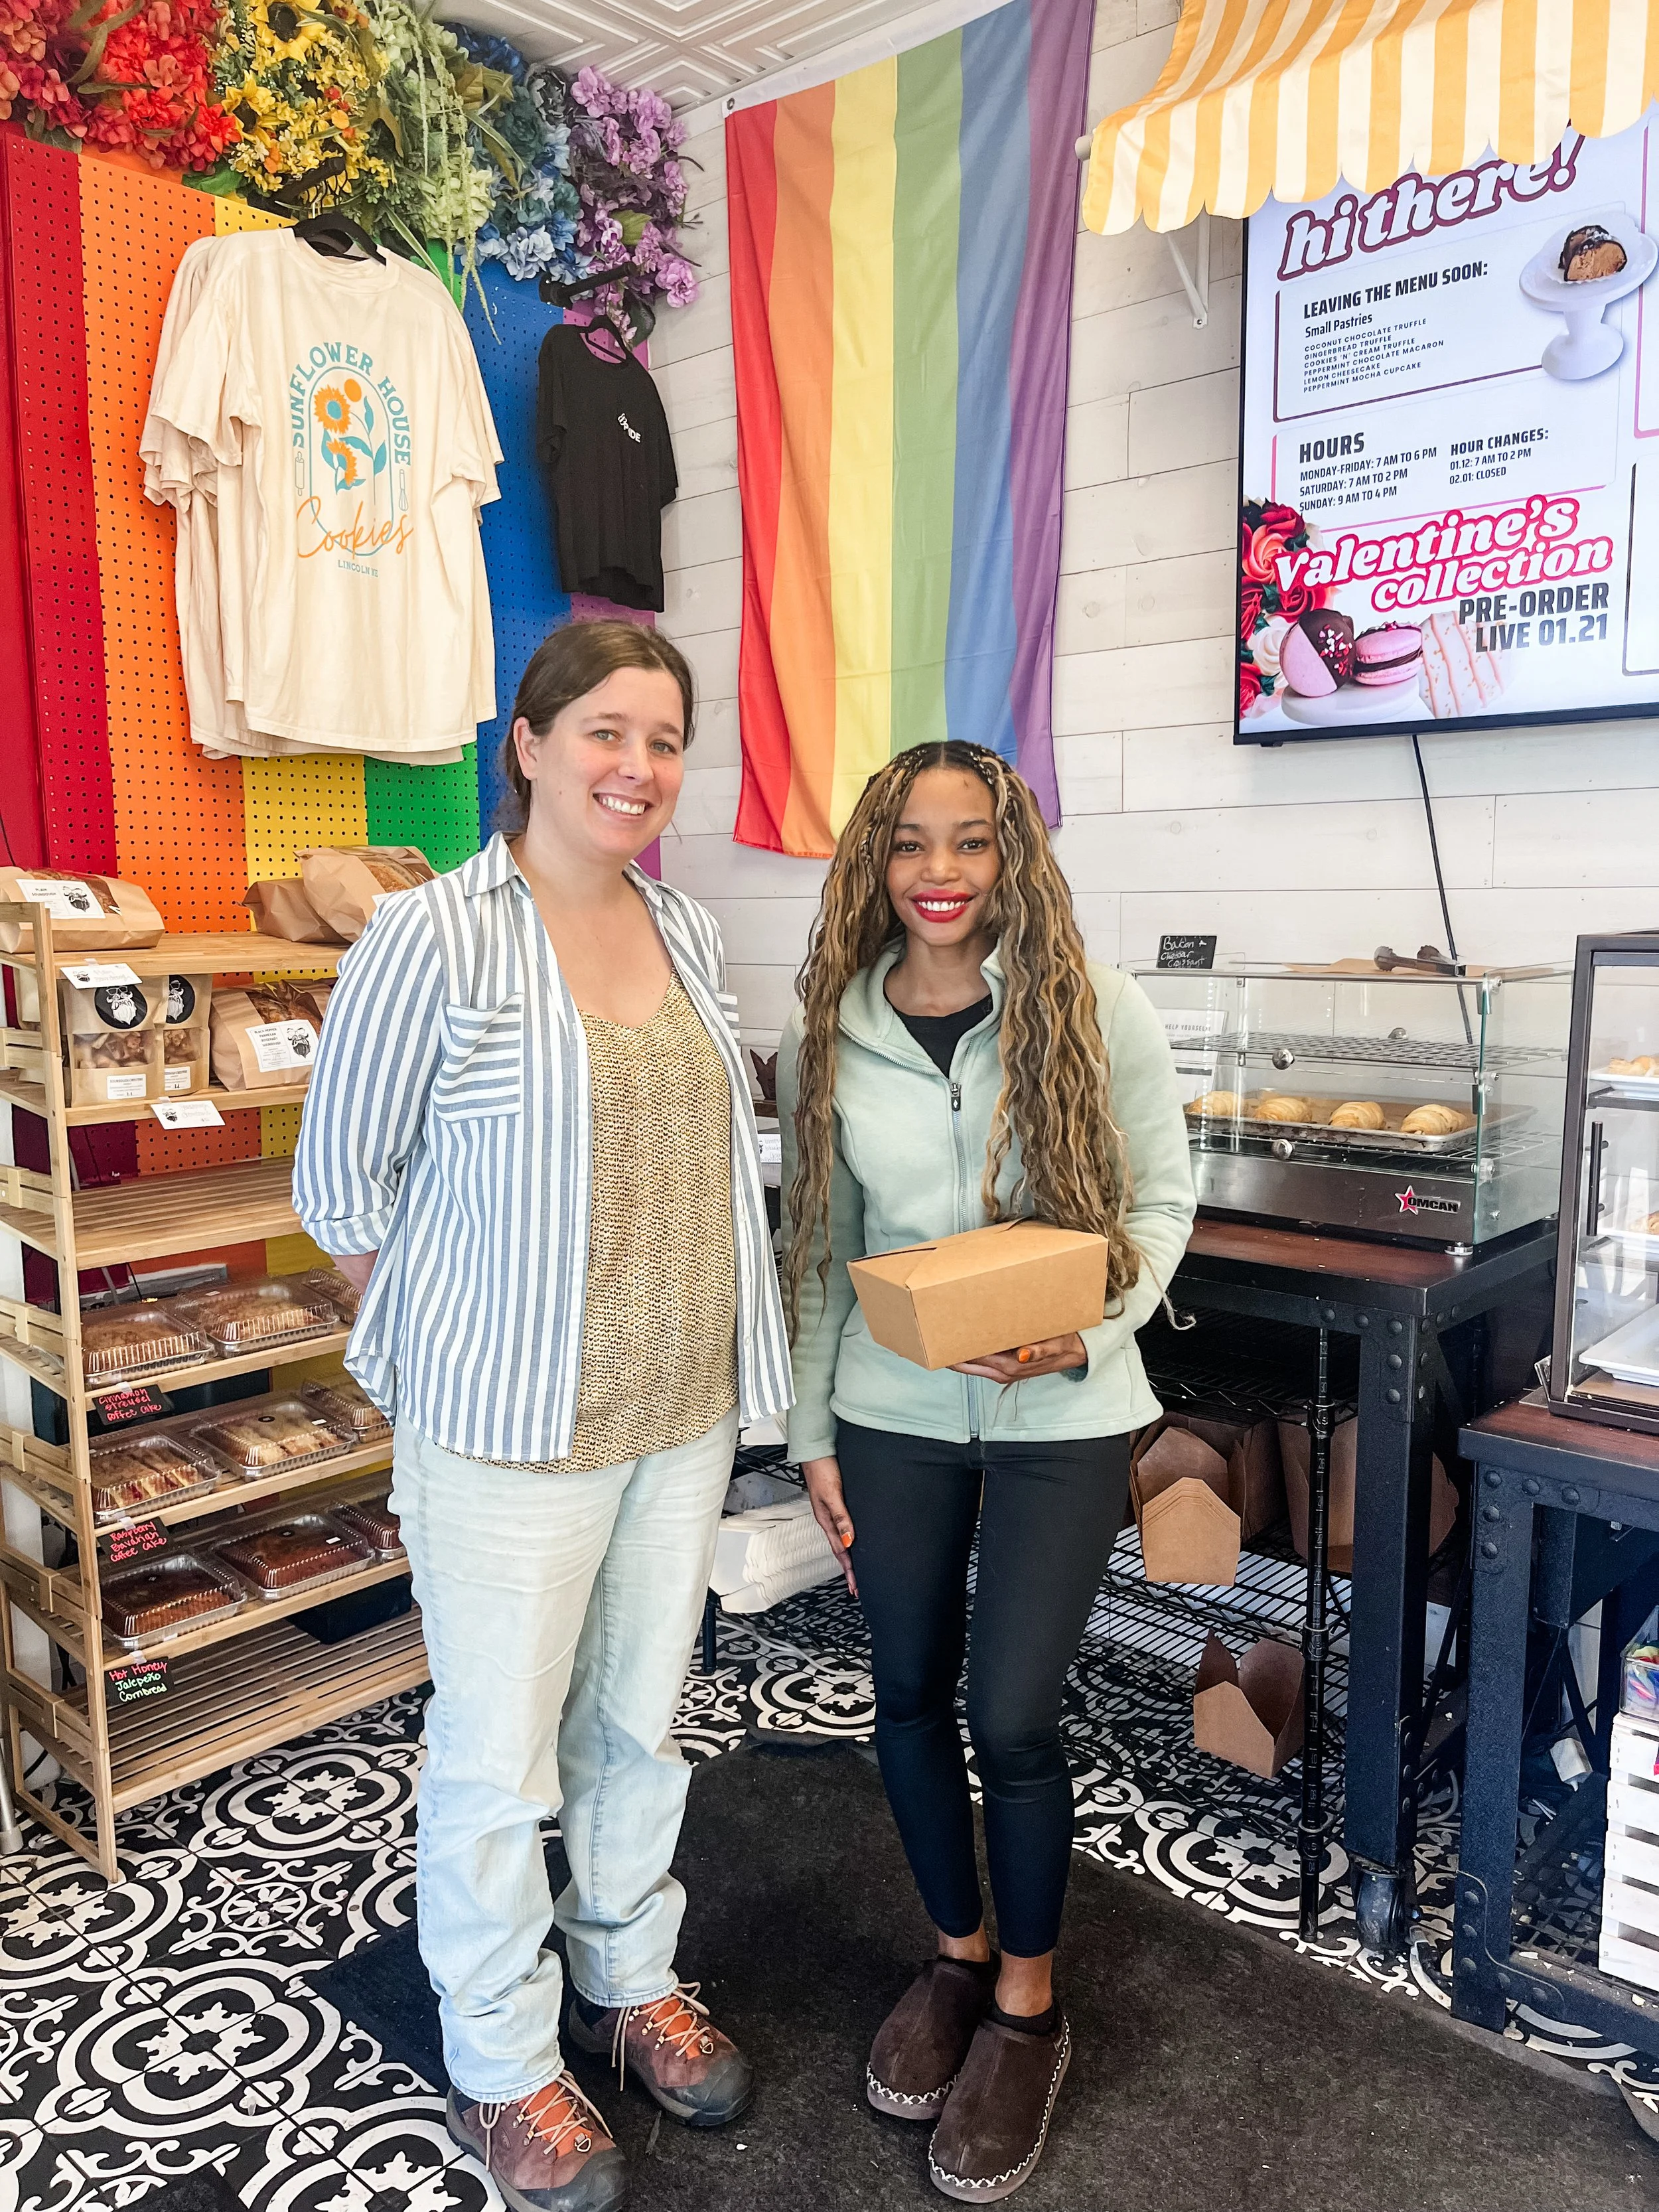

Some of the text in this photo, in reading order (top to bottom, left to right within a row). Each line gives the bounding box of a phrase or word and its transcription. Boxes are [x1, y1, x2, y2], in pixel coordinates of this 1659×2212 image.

[1303, 261, 1488, 319] LEAVING THE MENU SOON:
[1305, 313, 1373, 338] Small Pastries
[1305, 318, 1427, 352] COCONUT CHOCOLATE TRUFFLE
[1304, 356, 1338, 368] COOKIES
[1353, 344, 1380, 357] CREAM
[1383, 338, 1415, 351] TRUFFLE
[1304, 340, 1444, 376] PEPPERMINT CHOCOLATE MACARON
[1305, 334, 1392, 360] GINGERBREAD TRUFFLE
[1303, 362, 1421, 393] PEPPERMINT MOCHA CUPCAKE
[1304, 363, 1380, 385] LEMON CHEESECAKE
[290, 342, 411, 466] SUNFLOWER HOUSE
[1299, 432, 1364, 464] HOURS
[1451, 427, 1549, 456] HOUR CHANGES:
[1300, 447, 1437, 481] MONDAY-FRIDAY: 7 AM TO 6 PM
[1450, 447, 1531, 471] 01.12: 7 AM TO 2 PM
[1300, 468, 1407, 496] SATURDAY: 7 AM TO 2 PM
[1449, 467, 1506, 484] 02.01: CLOSED
[1299, 486, 1397, 512] SUNDAY: 9 AM TO 4 PM
[297, 496, 414, 559] Cookies
[338, 559, 370, 576] LINCOLN
[1372, 537, 1613, 612] collection
[1460, 582, 1609, 625] PRE-ORDER
[1476, 613, 1608, 652] LIVE 01.21
[1407, 1197, 1458, 1212] OMCAN
[109, 1661, 167, 1681] Hot Honey
[119, 1682, 167, 1702] Cornbread
